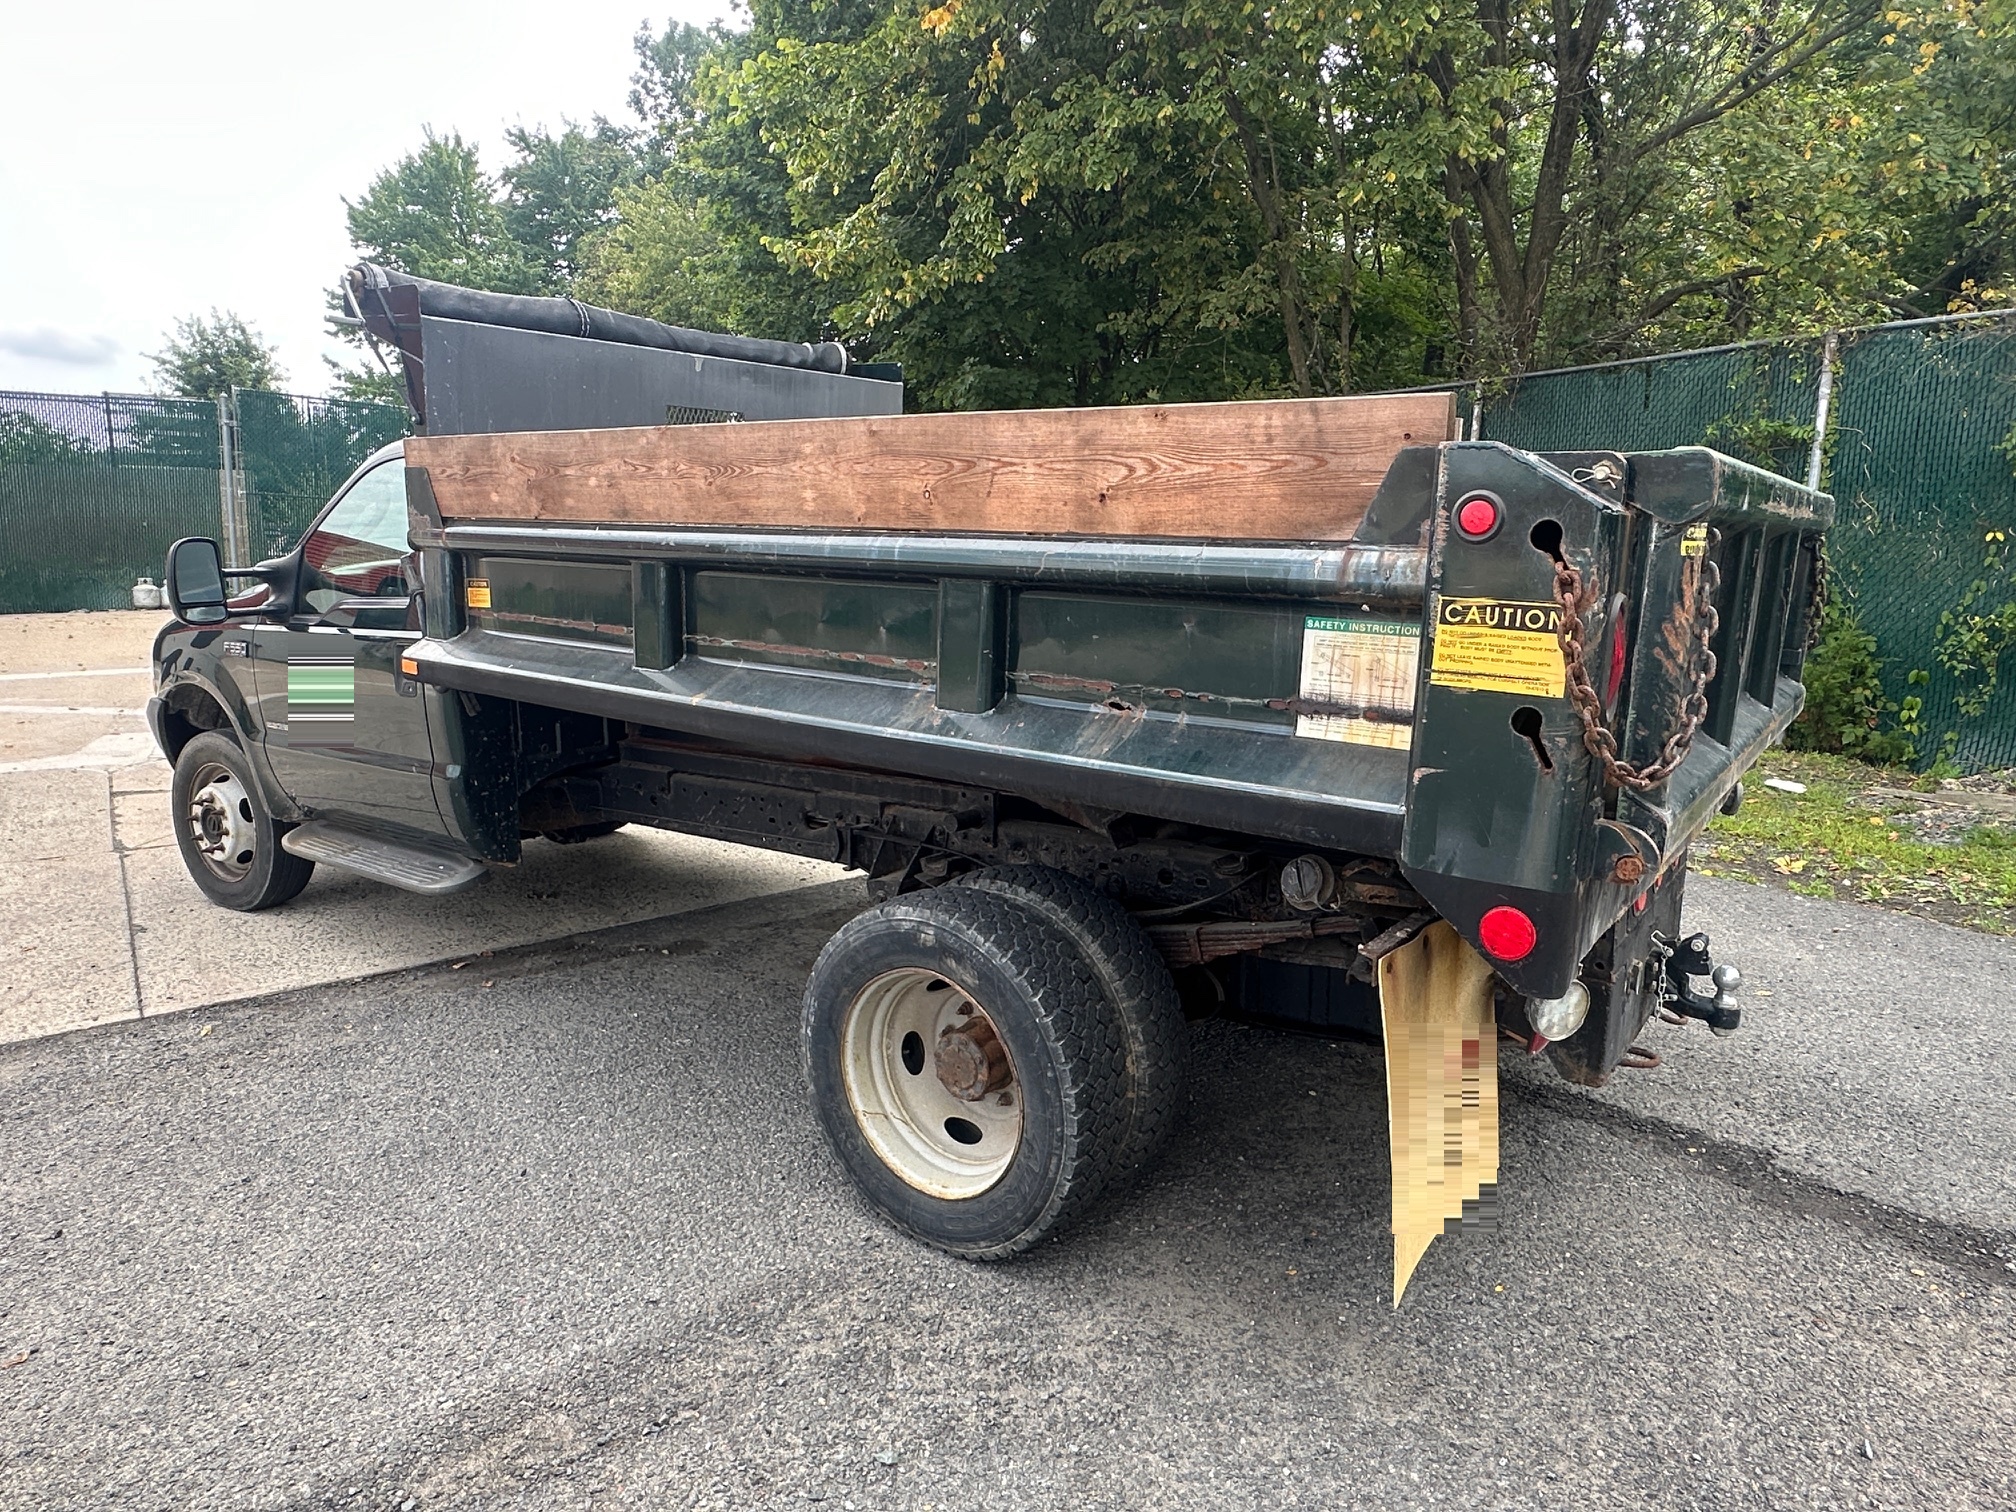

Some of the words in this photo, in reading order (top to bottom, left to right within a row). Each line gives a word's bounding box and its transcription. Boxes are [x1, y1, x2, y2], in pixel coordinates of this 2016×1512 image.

[1307, 619, 1346, 631] SAFETY
[1349, 622, 1420, 636] INSTRUCTION
[1444, 604, 1564, 630] CAUTION
